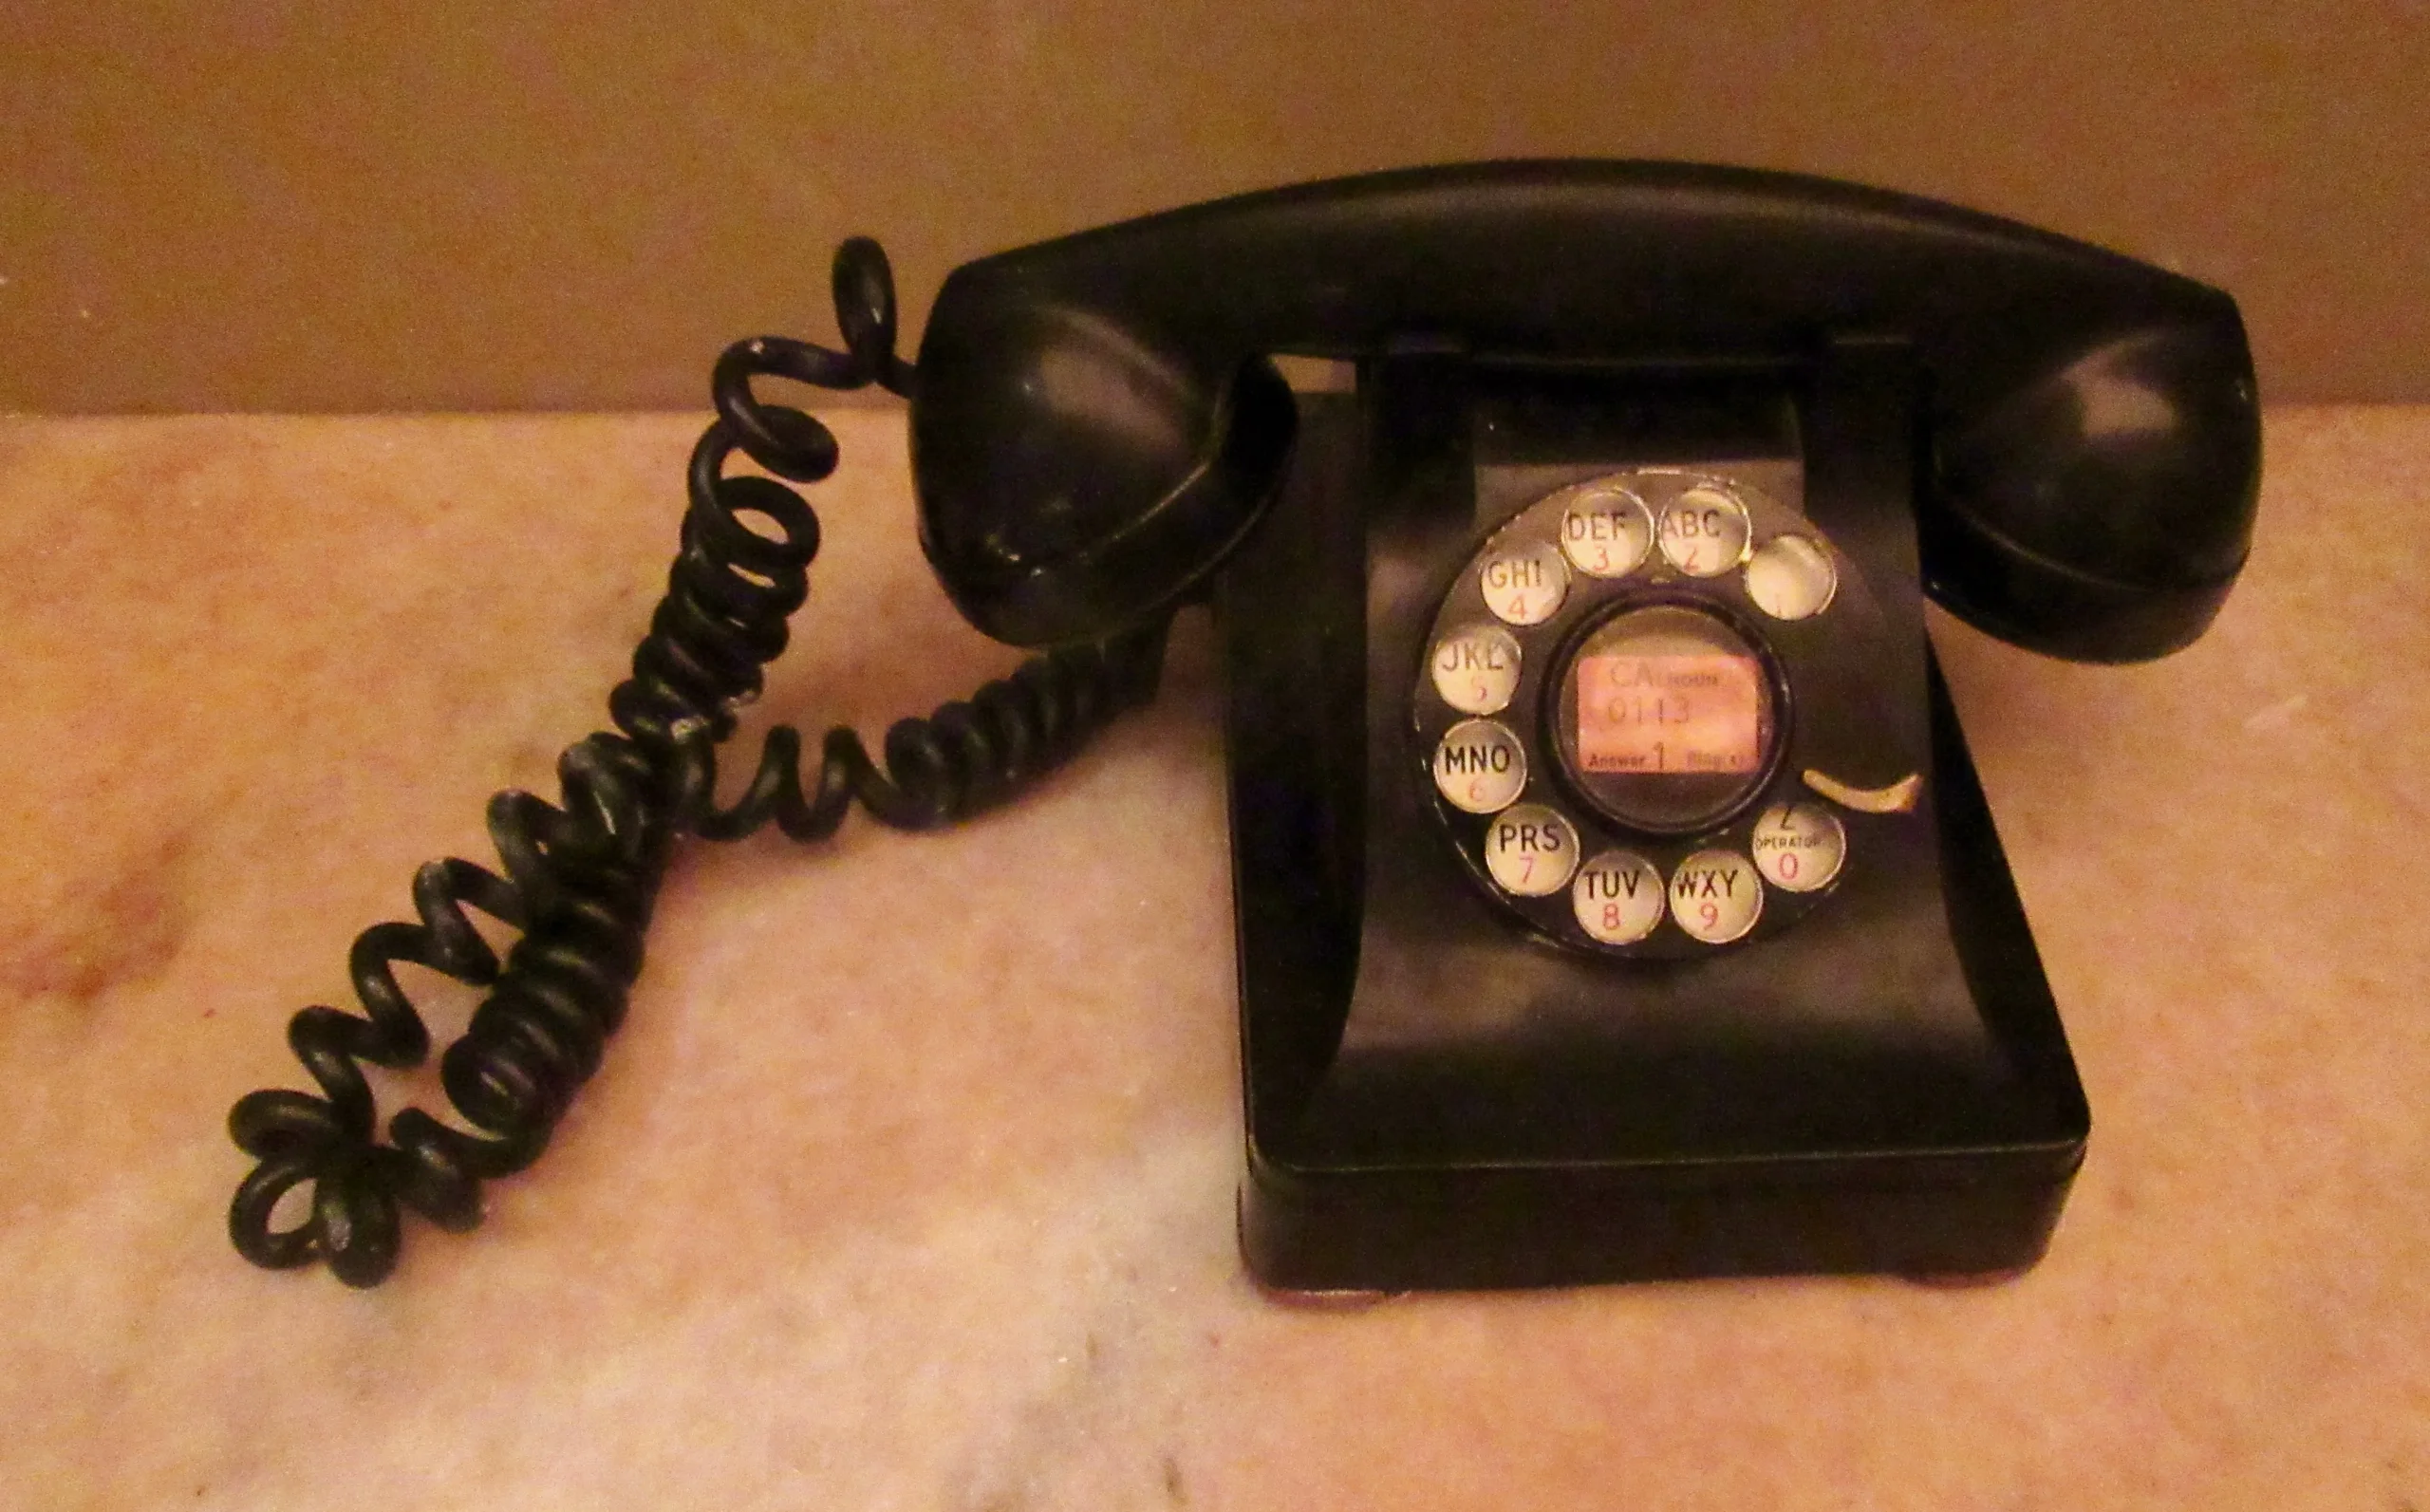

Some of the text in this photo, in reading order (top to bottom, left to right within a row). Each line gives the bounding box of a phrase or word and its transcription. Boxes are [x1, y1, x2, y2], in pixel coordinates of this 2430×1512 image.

[1567, 513, 1627, 541] DEF
[1662, 509, 1721, 538] ABC
[1593, 547, 1611, 572] 3
[1683, 544, 1701, 570] 2
[1487, 559, 1542, 589] GHI
[1507, 595, 1527, 620] 4
[1442, 641, 1505, 672] JKL
[1608, 695, 1690, 725] 0113
[1445, 744, 1510, 775] MNO
[1468, 777, 1486, 803] 6
[1499, 824, 1561, 853] PRS
[1520, 857, 1536, 886] 7
[1583, 869, 1641, 900] TUV
[1677, 868, 1739, 899] WXY
[1603, 902, 1620, 930] 8
[1700, 904, 1719, 930] 9
